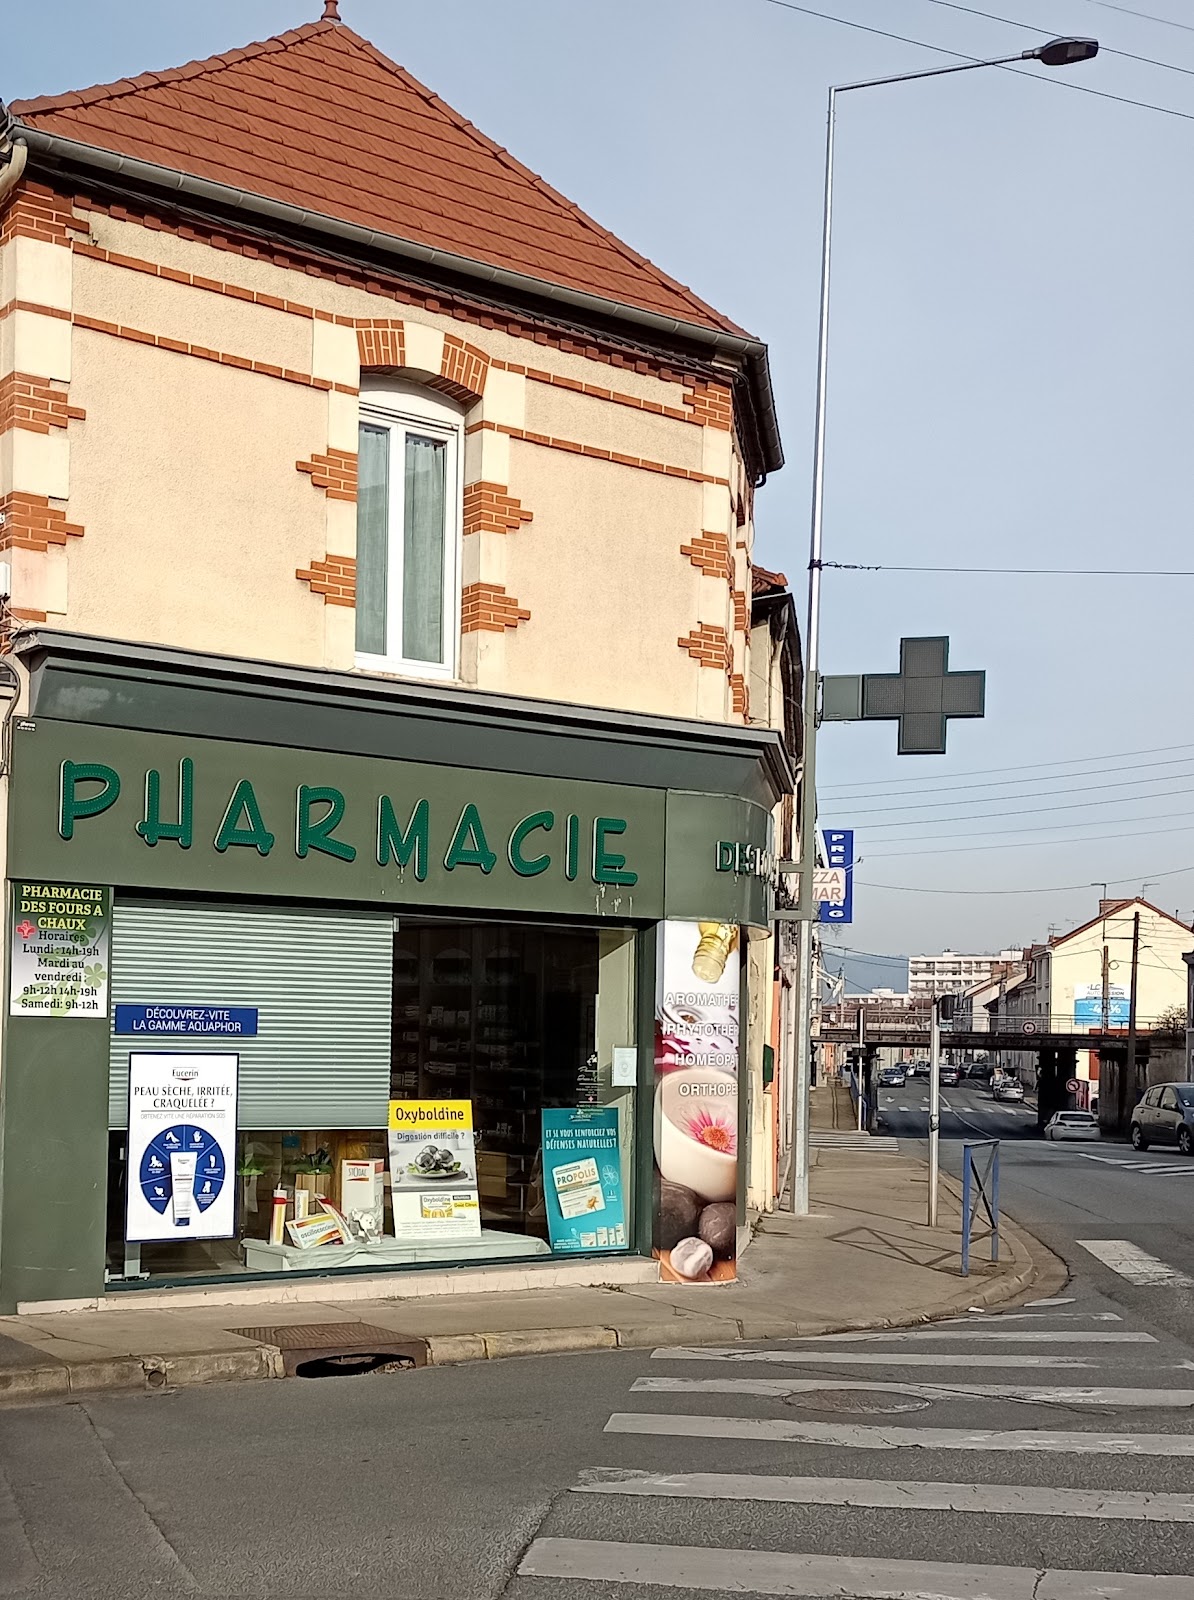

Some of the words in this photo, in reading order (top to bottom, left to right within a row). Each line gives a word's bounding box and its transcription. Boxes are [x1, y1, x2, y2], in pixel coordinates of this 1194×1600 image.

[58, 757, 638, 885] PHARMACIE
[21, 885, 103, 901] PHARMACIE
[20, 901, 46, 913] DES
[48, 902, 92, 916] FOURS
[92, 905, 104, 917] A
[37, 917, 86, 931] CHAUX
[38, 930, 85, 942] Horaires
[22, 943, 54, 954] Lundi
[37, 957, 70, 969] Mardi
[71, 960, 85, 969] au
[34, 971, 82, 983] vendredi
[22, 984, 57, 996] 9h-12h
[59, 985, 98, 997] 14h-19h
[65, 999, 99, 1010] 9h-12h
[146, 1007, 230, 1020] DÉCOUVREZ-VITE
[133, 1020, 147, 1030] LA
[148, 1021, 187, 1031] GAMME
[187, 1021, 242, 1033] AQUAPHOR
[172, 1069, 198, 1077] Eucerin
[134, 1086, 159, 1096] PEAU
[162, 1084, 194, 1097] SÈCHE,
[197, 1084, 233, 1098] IRRITÉE,
[153, 1096, 208, 1109] CRAQUELÉE
[395, 1106, 465, 1124] Oxyboldine
[397, 1132, 432, 1142] Digestion
[433, 1131, 459, 1140] difficile
[556, 1167, 596, 1186] PROPOLIS
